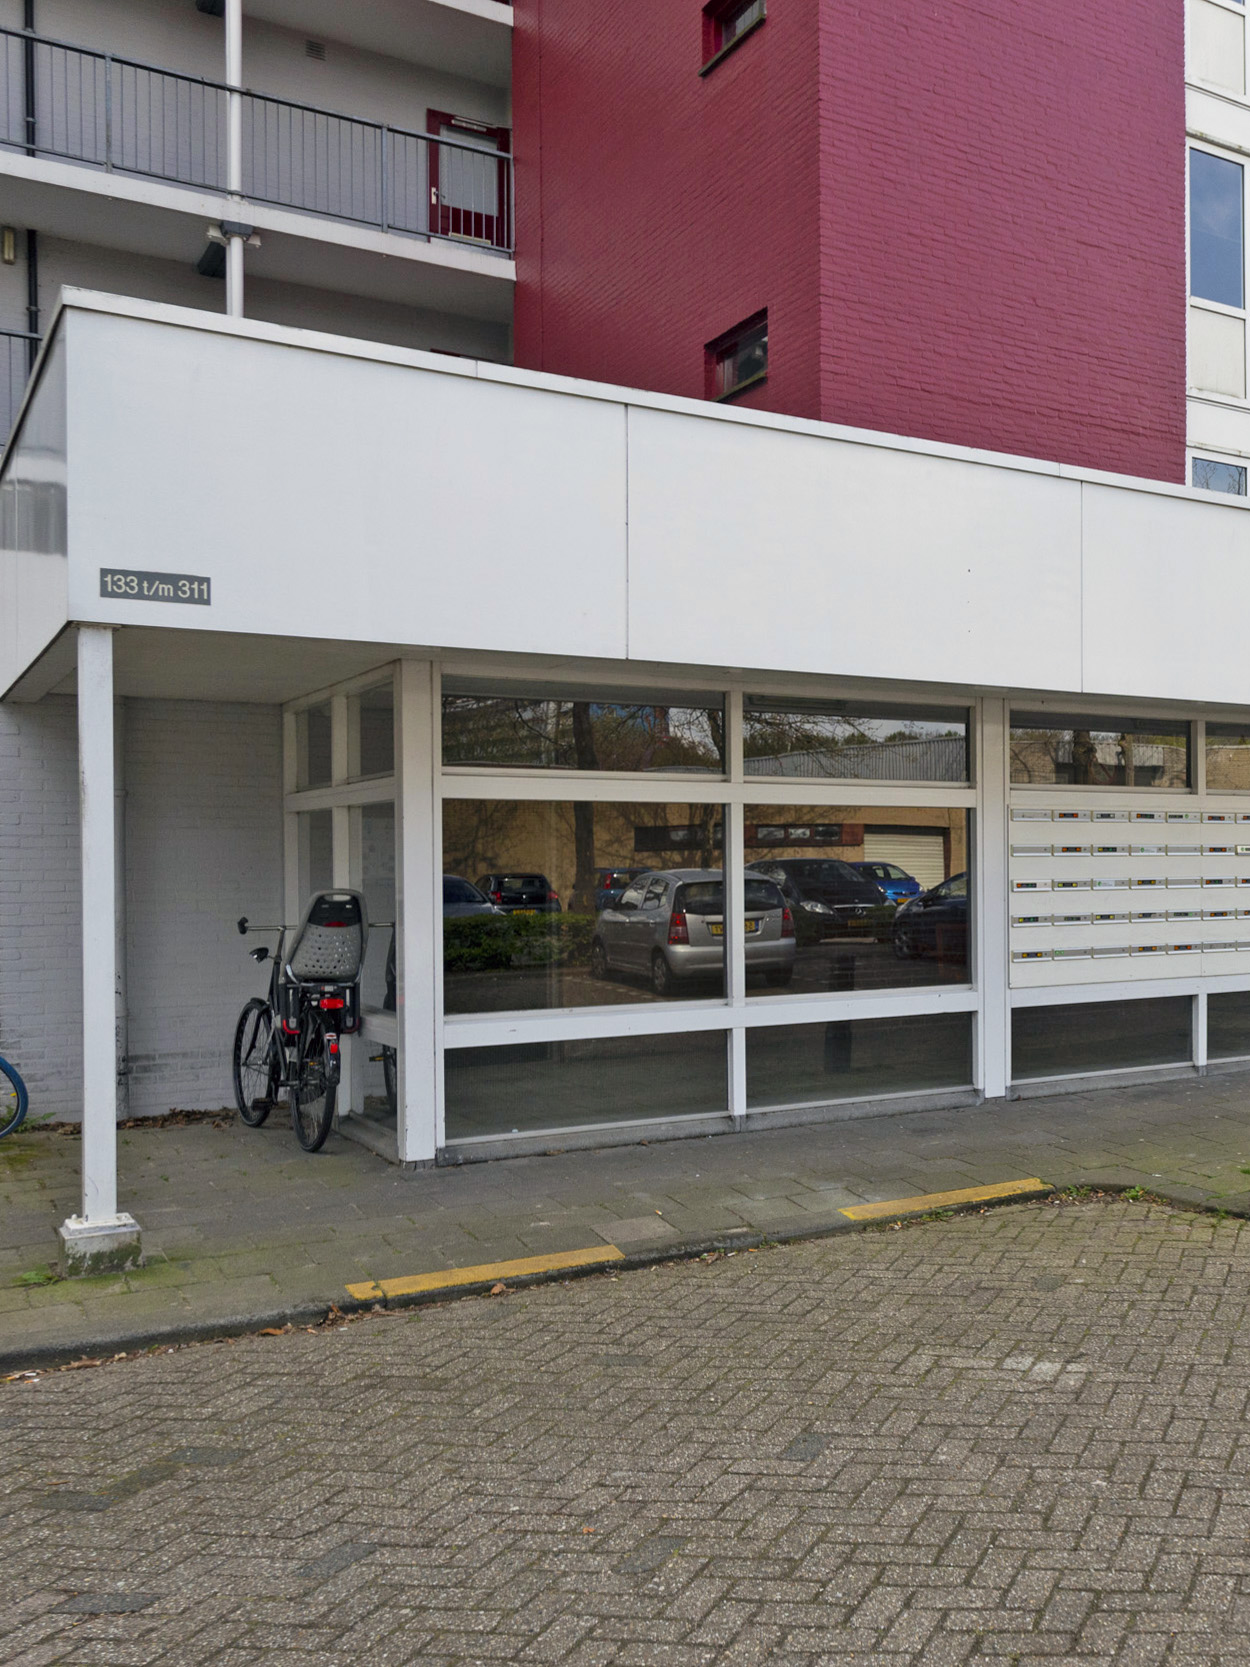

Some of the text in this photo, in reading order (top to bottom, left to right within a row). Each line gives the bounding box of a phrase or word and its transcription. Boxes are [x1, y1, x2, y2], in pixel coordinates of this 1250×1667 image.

[103, 574, 208, 599] 133 t/m 311
